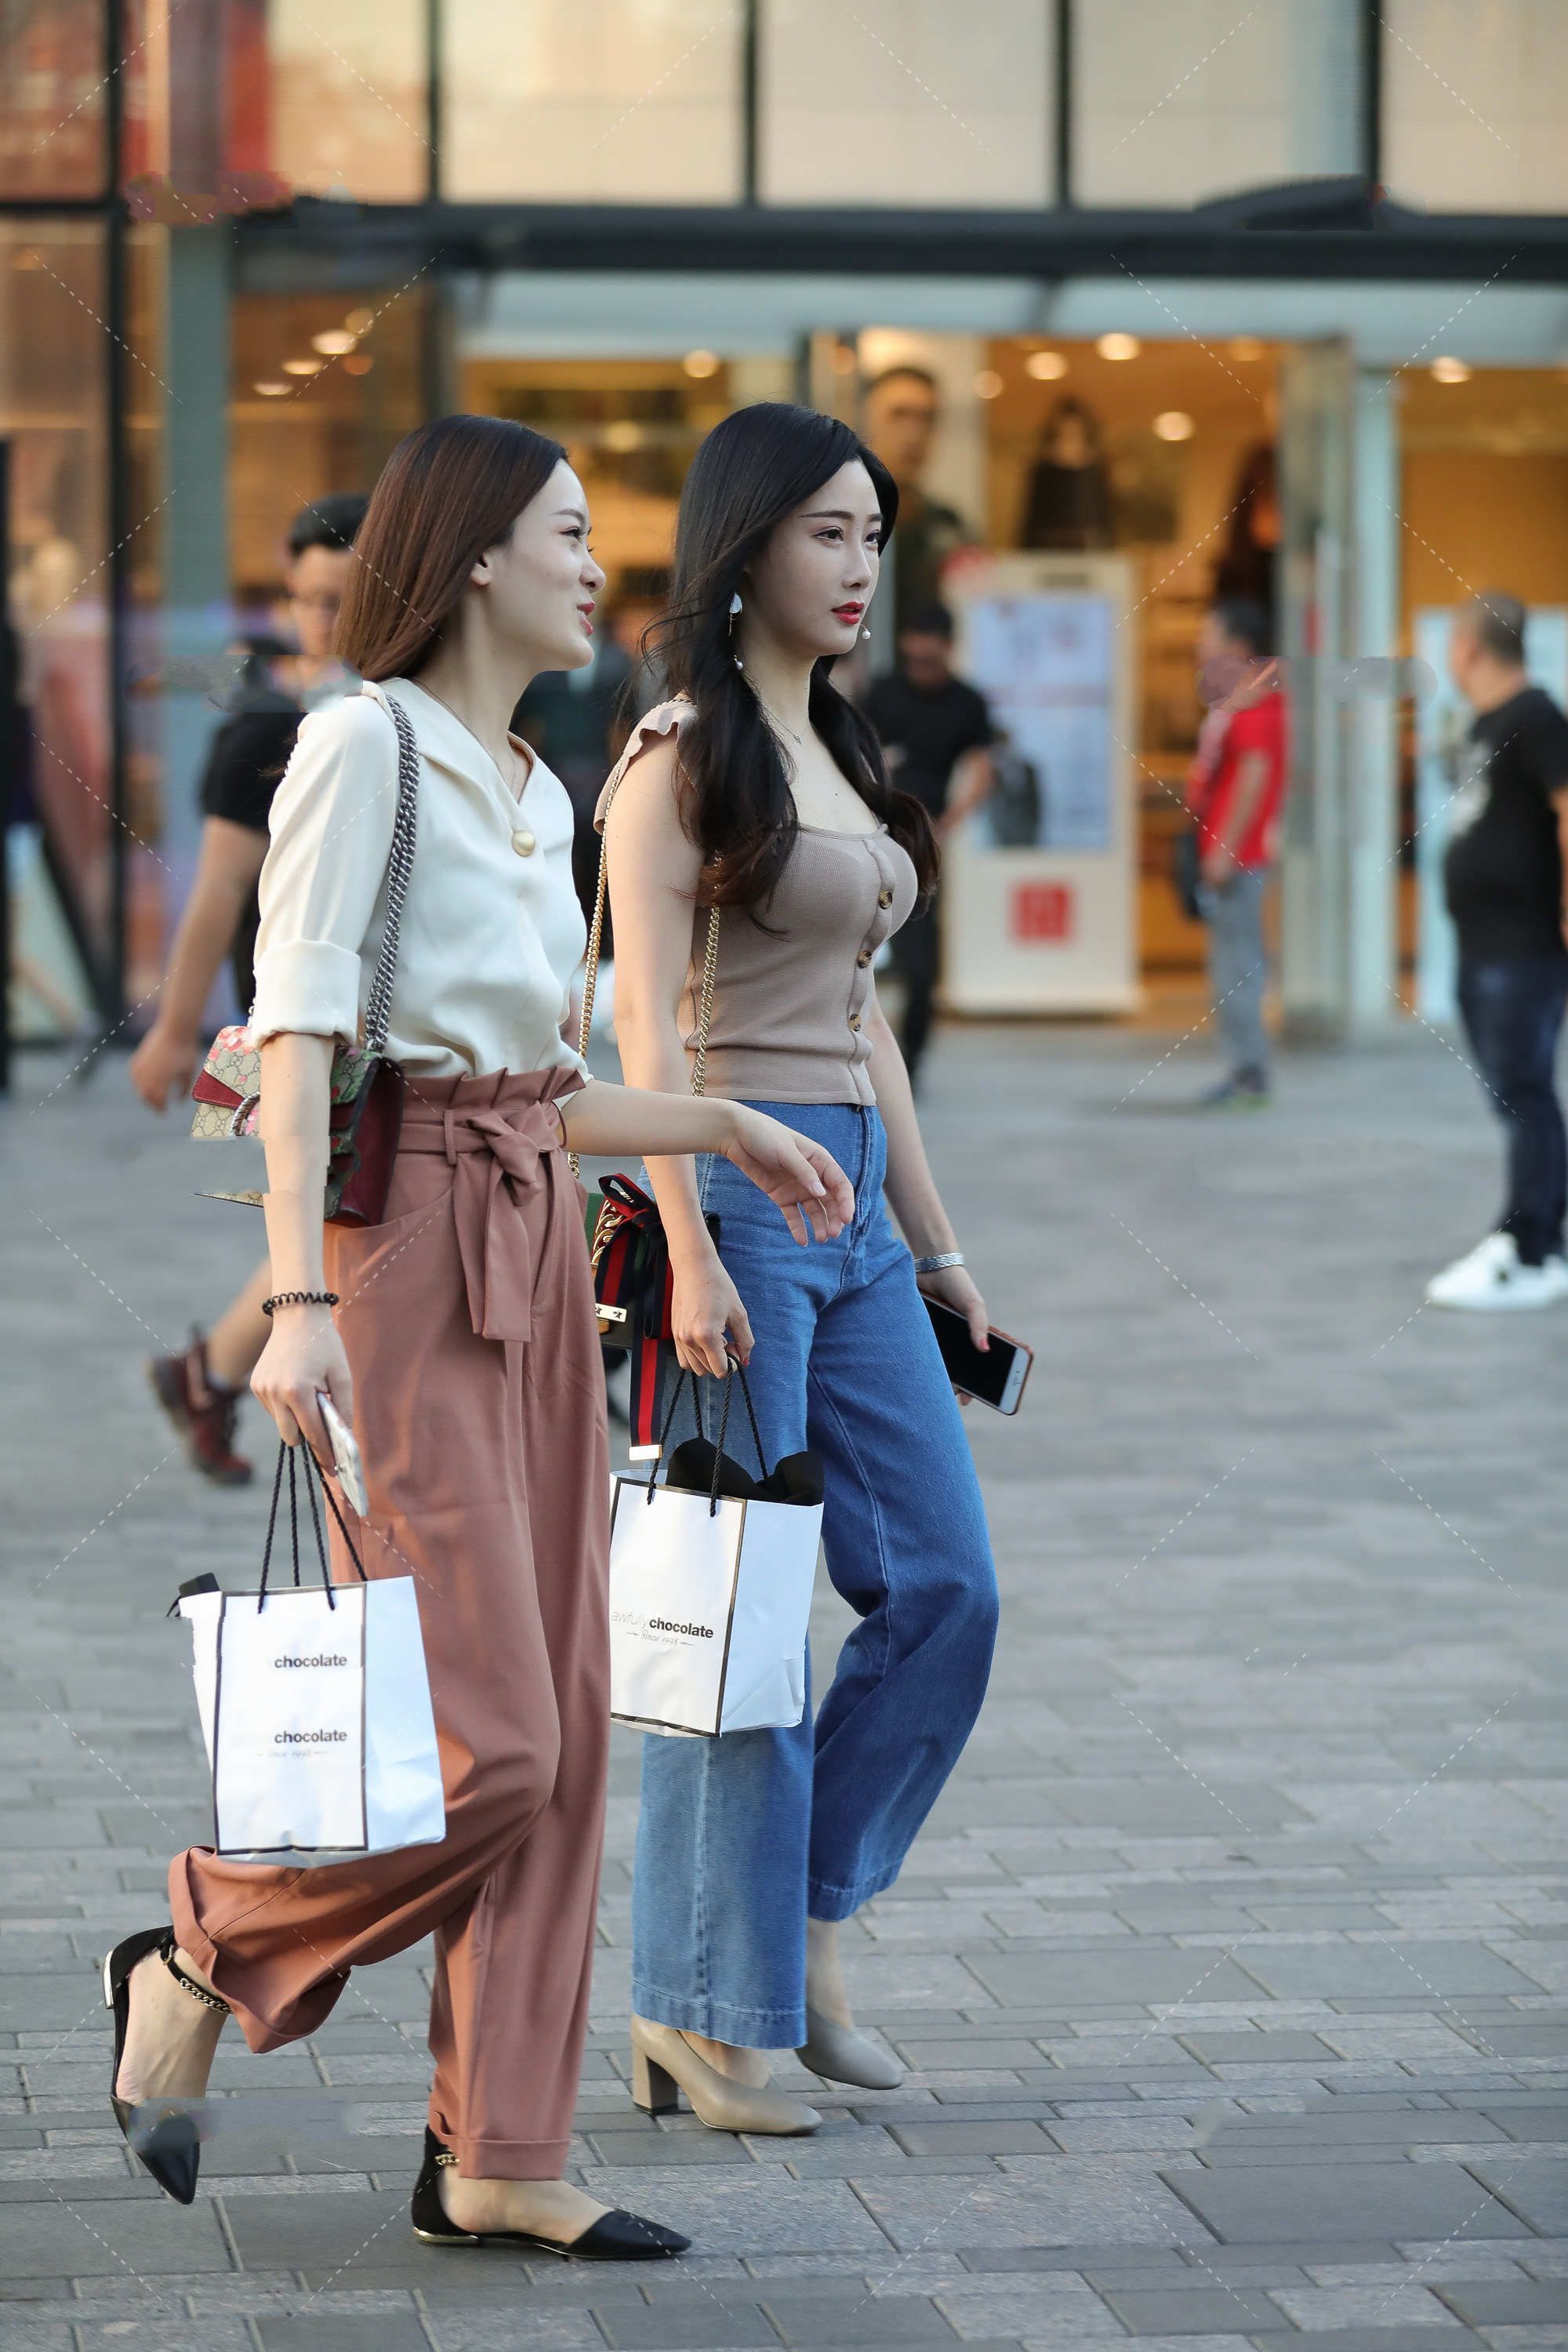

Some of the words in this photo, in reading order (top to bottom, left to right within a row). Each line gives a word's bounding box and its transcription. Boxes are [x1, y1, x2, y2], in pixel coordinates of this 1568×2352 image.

[649, 1617, 713, 1639] chocolate
[274, 1653, 347, 1668] chocolate
[274, 1729, 347, 1744] chocolate
